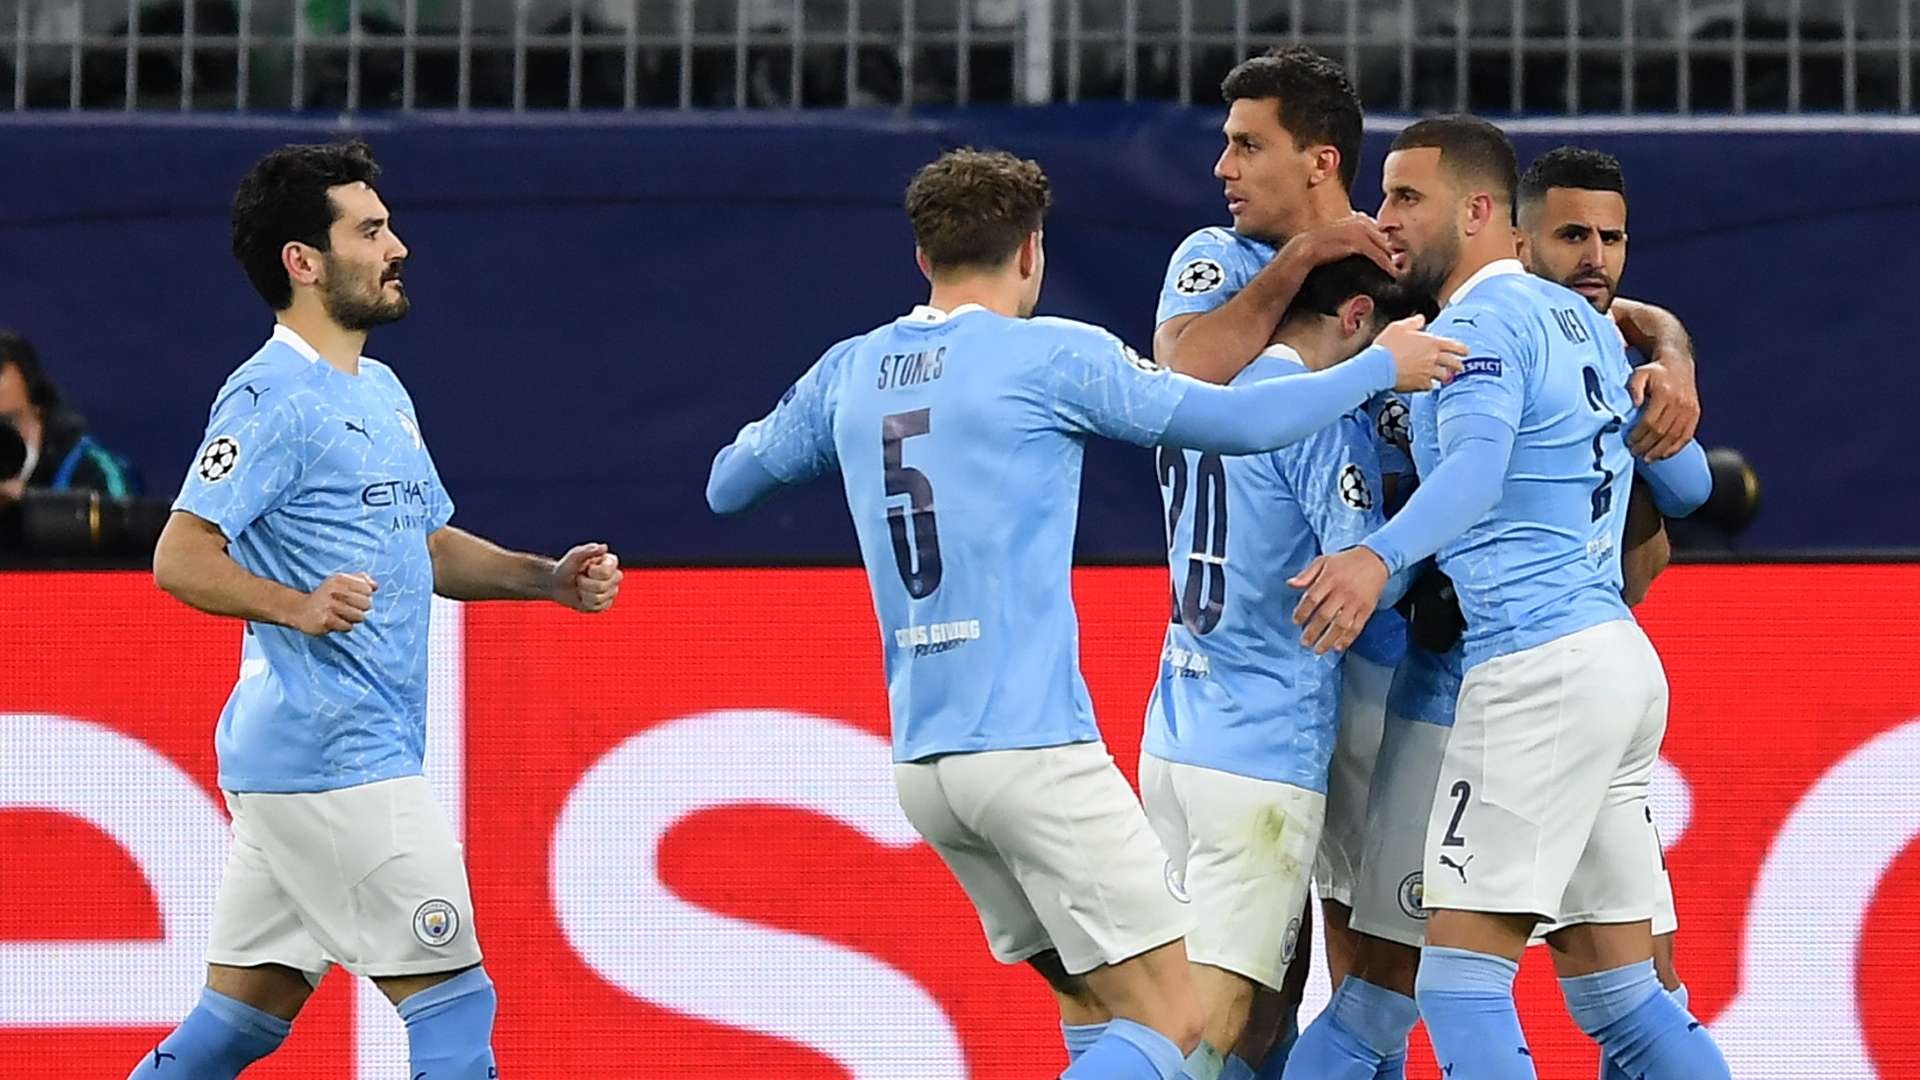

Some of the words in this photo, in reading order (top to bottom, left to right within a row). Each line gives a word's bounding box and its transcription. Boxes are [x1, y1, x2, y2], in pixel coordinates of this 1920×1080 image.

[1464, 360, 1501, 374] SPECT
[882, 406, 943, 600] 5
[1155, 444, 1229, 635] 20
[1441, 780, 1472, 848] 2
